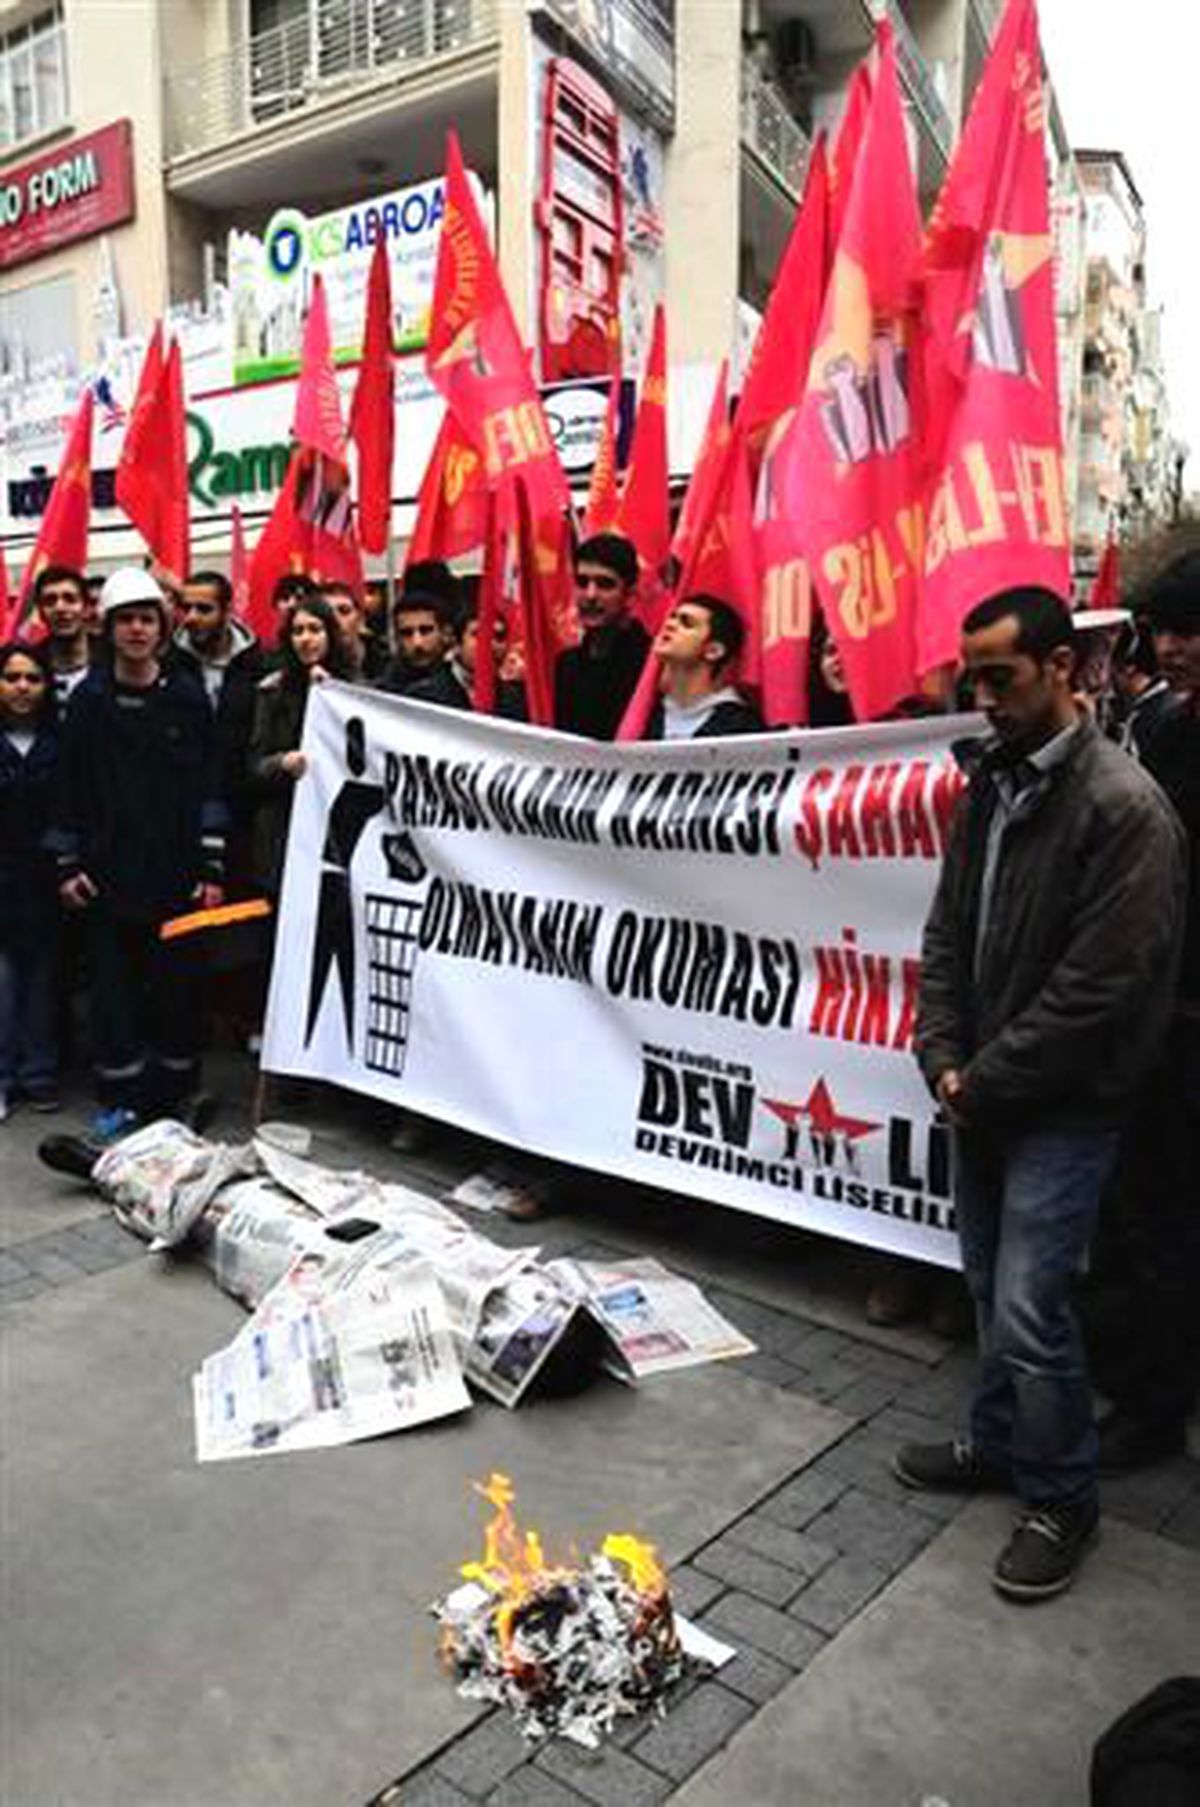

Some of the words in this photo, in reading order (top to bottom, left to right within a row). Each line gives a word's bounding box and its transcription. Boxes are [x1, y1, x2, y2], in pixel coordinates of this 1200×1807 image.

[27, 150, 99, 215] FORM
[186, 409, 299, 509] Ram
[795, 757, 966, 871] ŞAHAN
[418, 876, 603, 986] OLMAYANIN
[606, 910, 800, 1028] OKUMASI
[808, 926, 923, 1052] HİKA
[637, 1058, 756, 1150] DEV
[889, 1112, 953, 1198] Lİ
